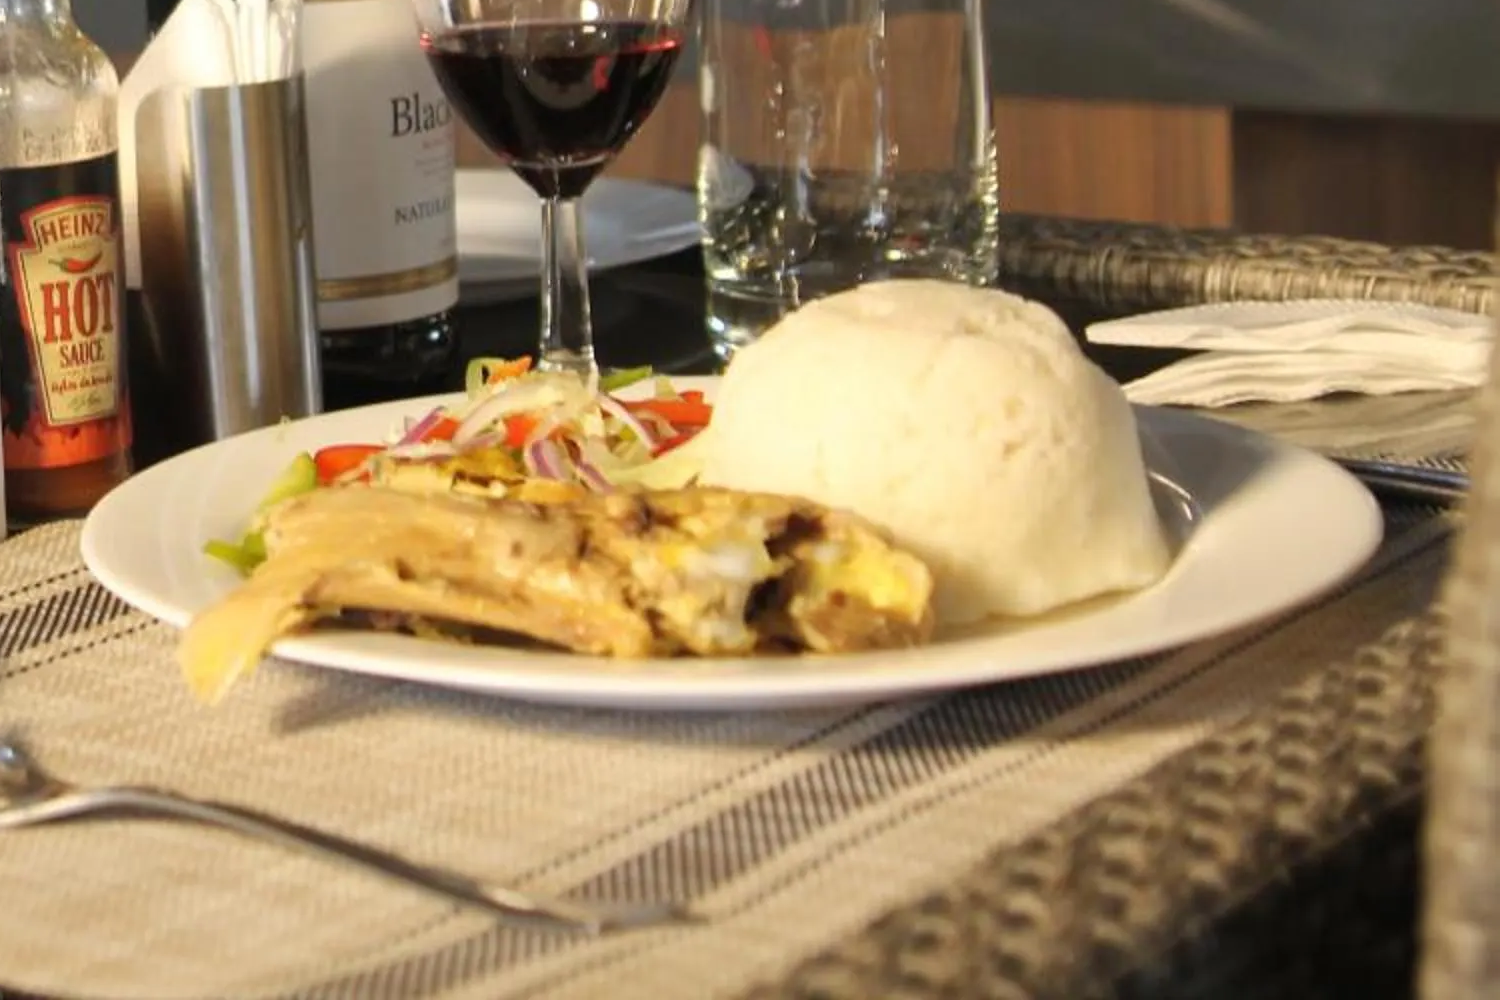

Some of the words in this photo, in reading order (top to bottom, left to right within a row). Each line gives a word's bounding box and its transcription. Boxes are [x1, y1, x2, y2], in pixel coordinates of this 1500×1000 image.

[391, 92, 451, 137] Blac
[40, 211, 106, 246] HEINZ
[41, 272, 115, 345] HOT
[59, 338, 106, 368] SAUCE
